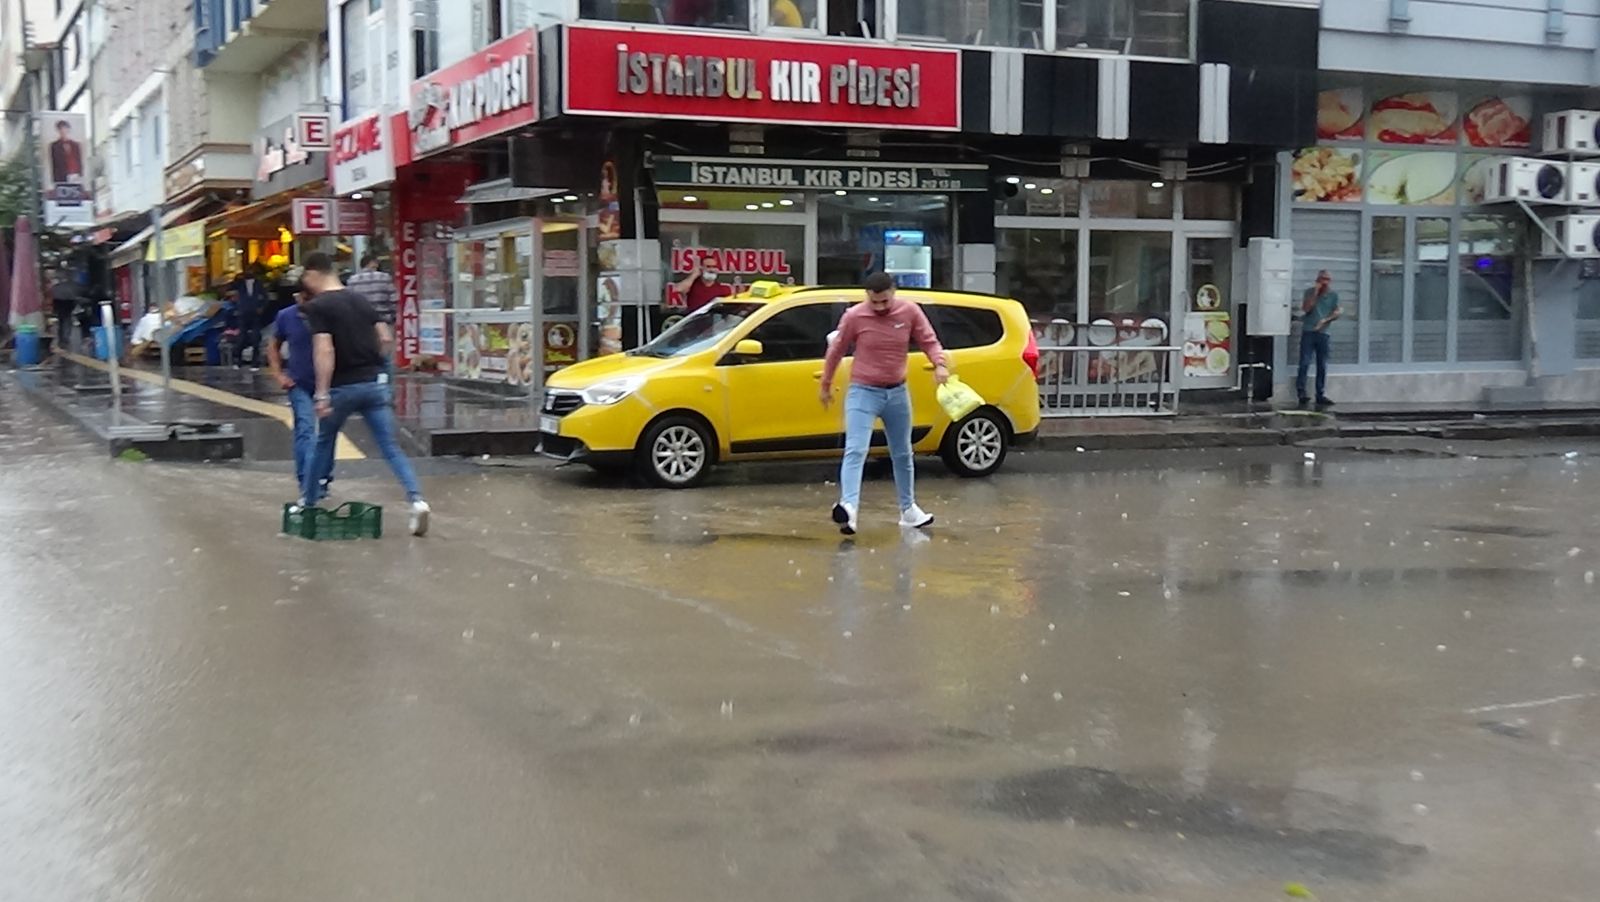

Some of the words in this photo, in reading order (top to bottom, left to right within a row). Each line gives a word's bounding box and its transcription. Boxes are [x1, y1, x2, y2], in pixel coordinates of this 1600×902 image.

[616, 43, 763, 102] İSTANBUL
[770, 58, 822, 104] KIR
[829, 58, 920, 109] PİDESİ
[306, 120, 324, 144] E
[691, 161, 799, 187] İSTANBUL
[804, 169, 843, 188] KIR
[847, 167, 918, 189] PİDESİ
[304, 204, 326, 229] E
[402, 221, 419, 359] ECZANE
